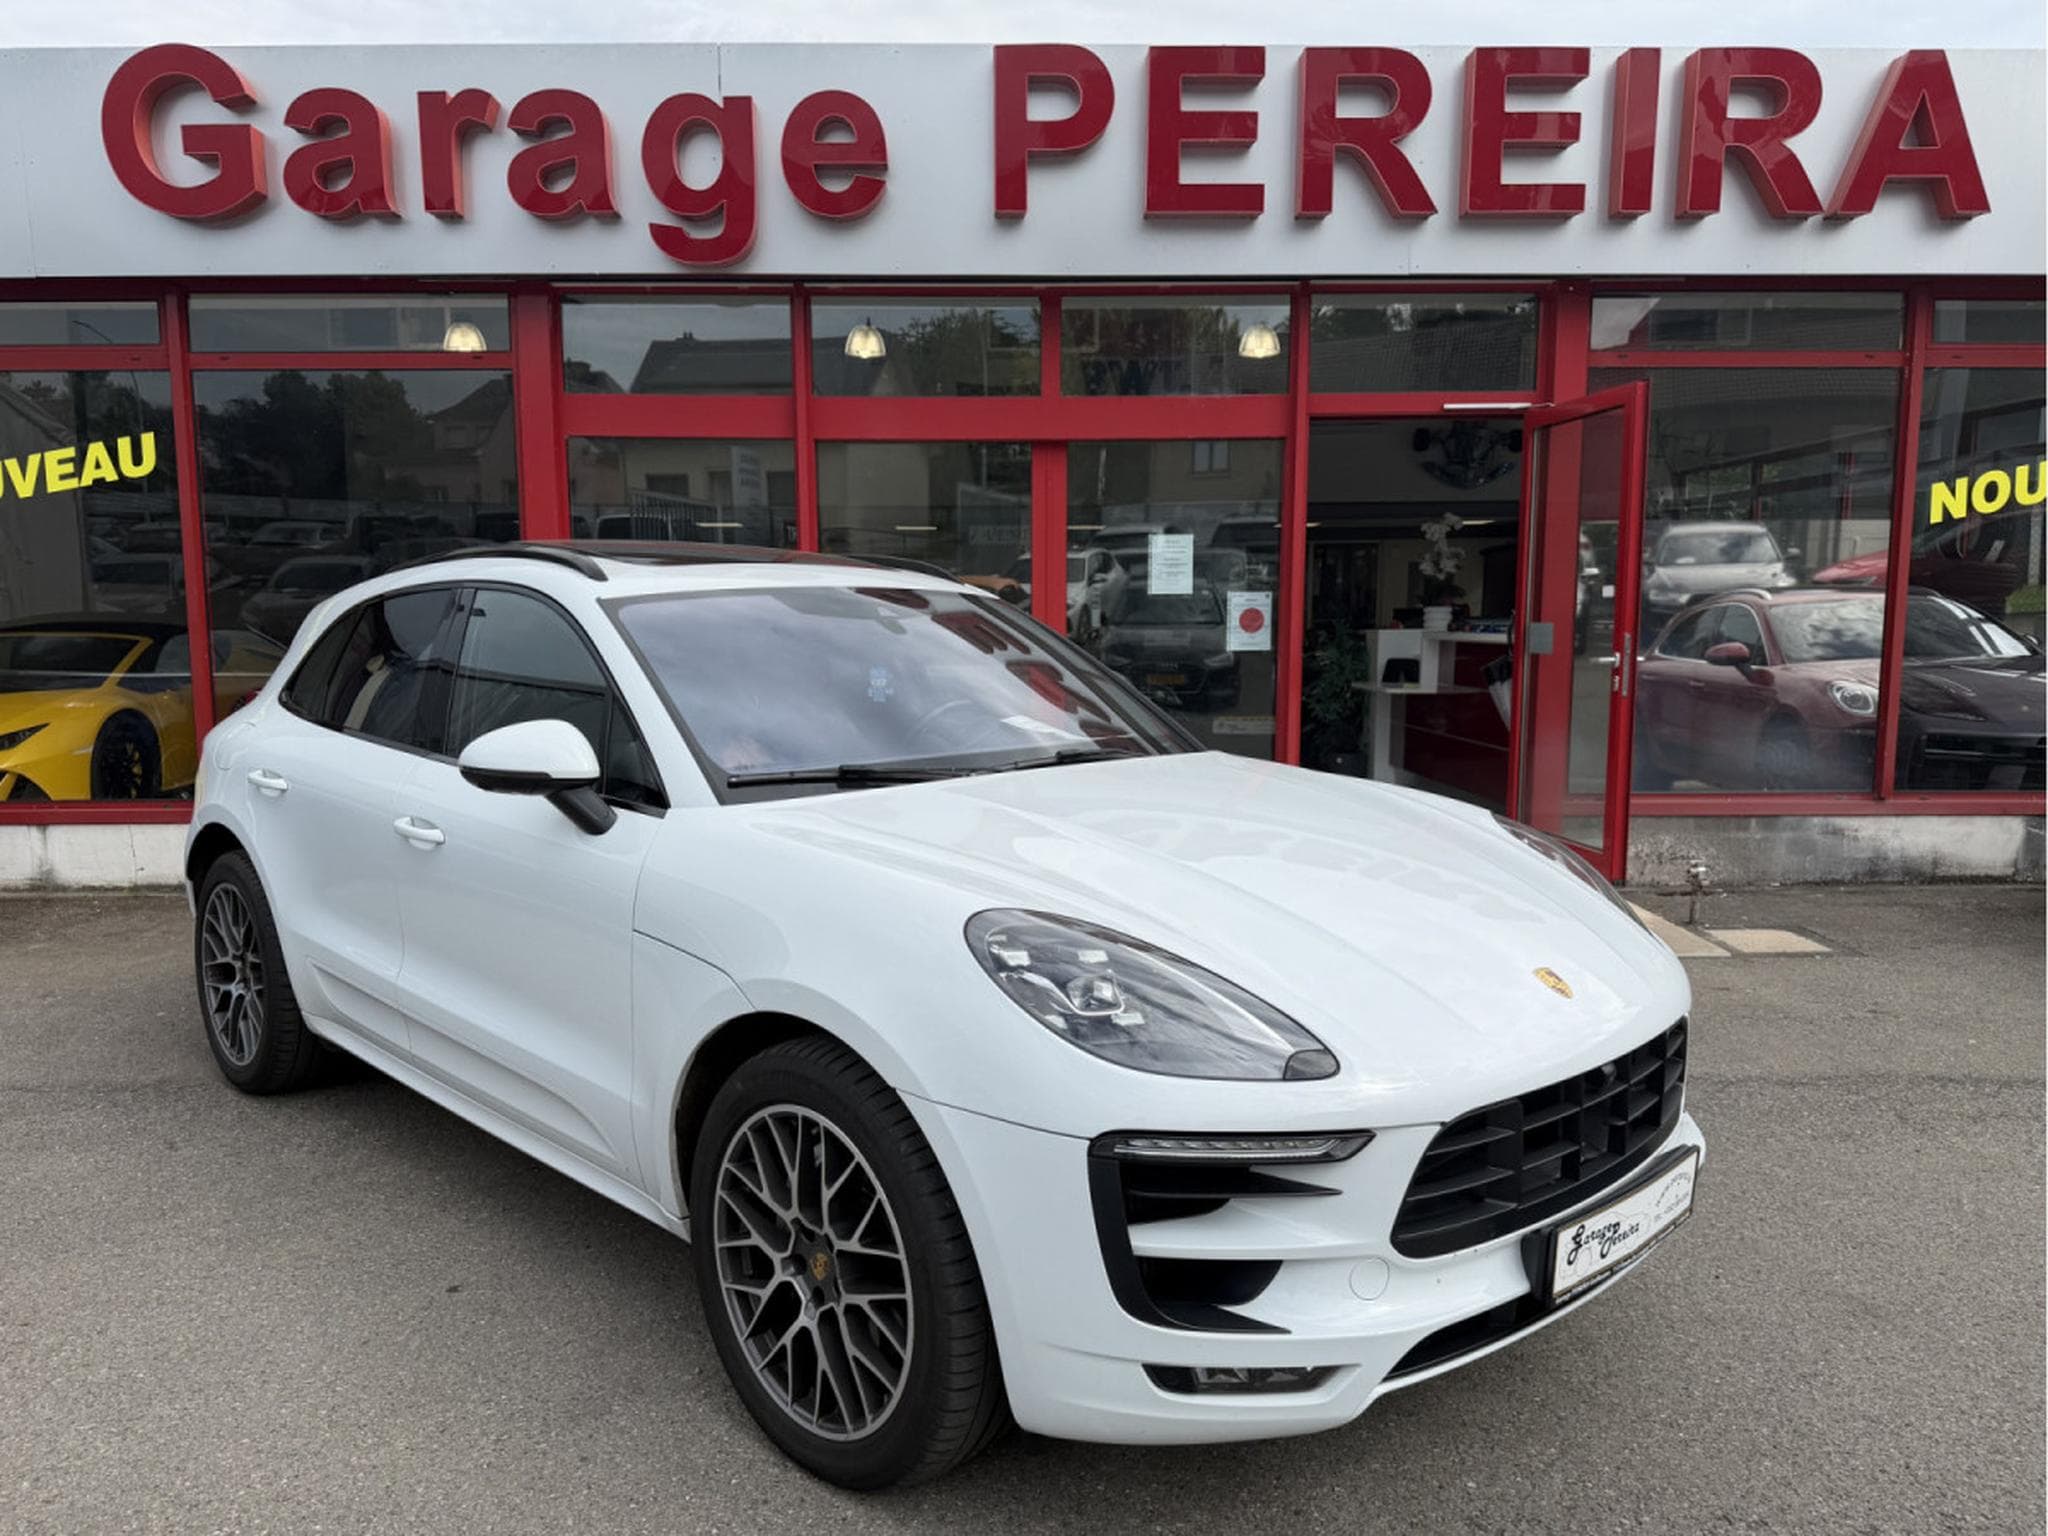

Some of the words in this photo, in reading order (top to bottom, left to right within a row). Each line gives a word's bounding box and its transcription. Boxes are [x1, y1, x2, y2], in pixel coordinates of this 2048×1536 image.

[101, 43, 888, 267] Garage
[993, 44, 1992, 221] PEREIRA
[0, 431, 156, 499] VEAU
